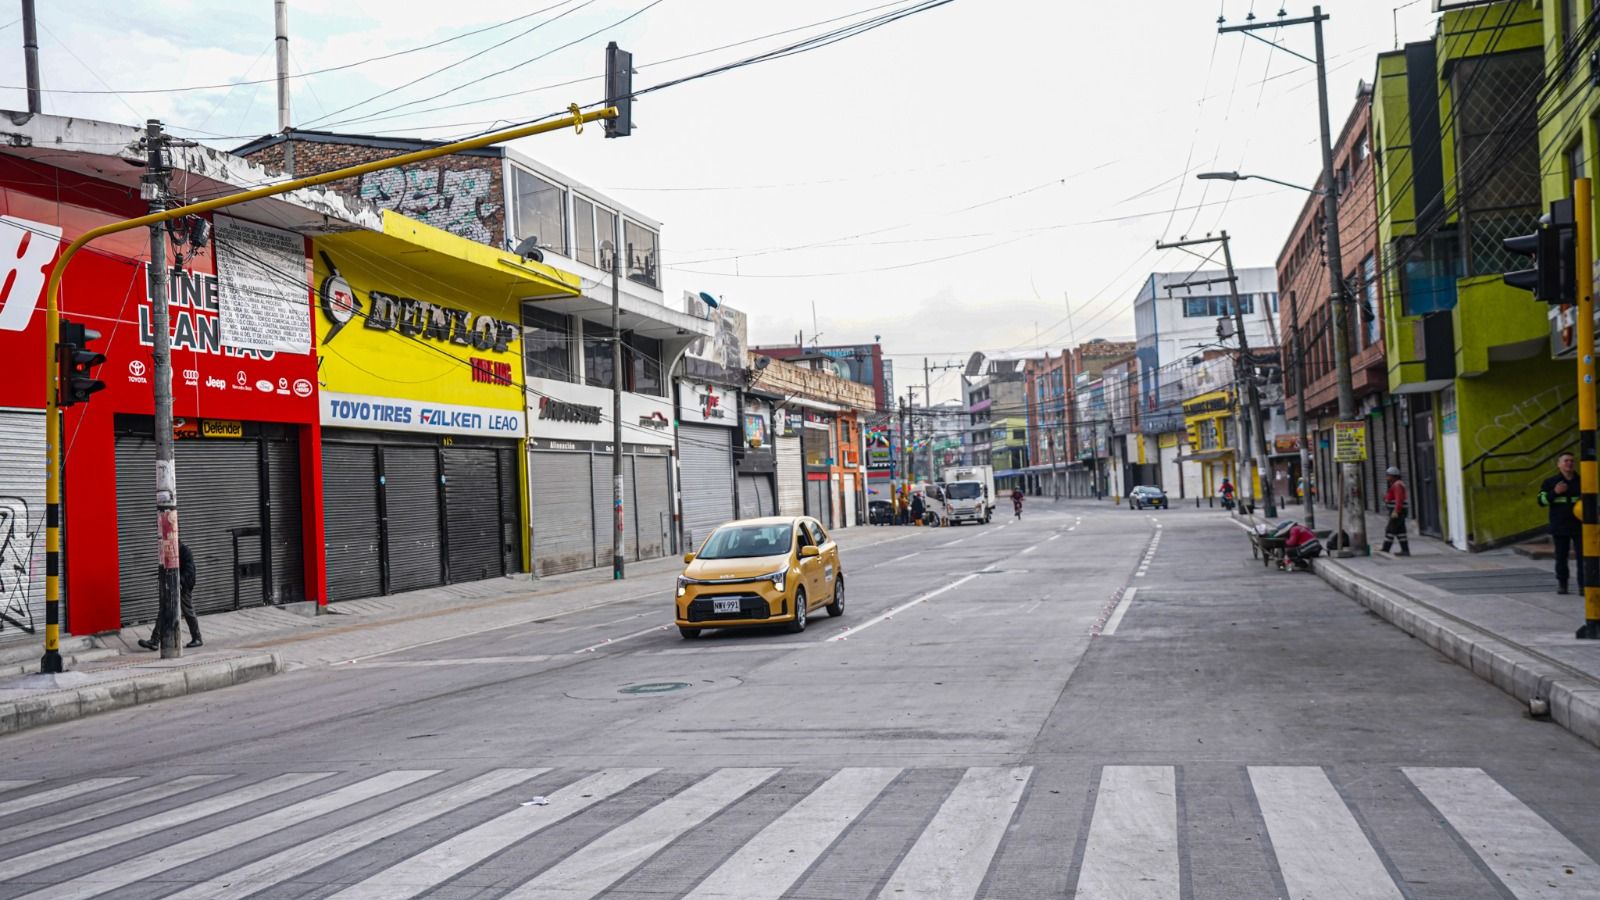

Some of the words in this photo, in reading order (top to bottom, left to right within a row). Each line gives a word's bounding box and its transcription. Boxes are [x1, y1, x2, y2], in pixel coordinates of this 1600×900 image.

[364, 291, 520, 353] DUNLOP
[206, 376, 227, 390] Jeep
[331, 400, 370, 420] TOYO
[372, 404, 411, 423] TIRES
[418, 408, 481, 428] FALKEN
[204, 422, 242, 435] Defender
[489, 415, 518, 431] LEAO
